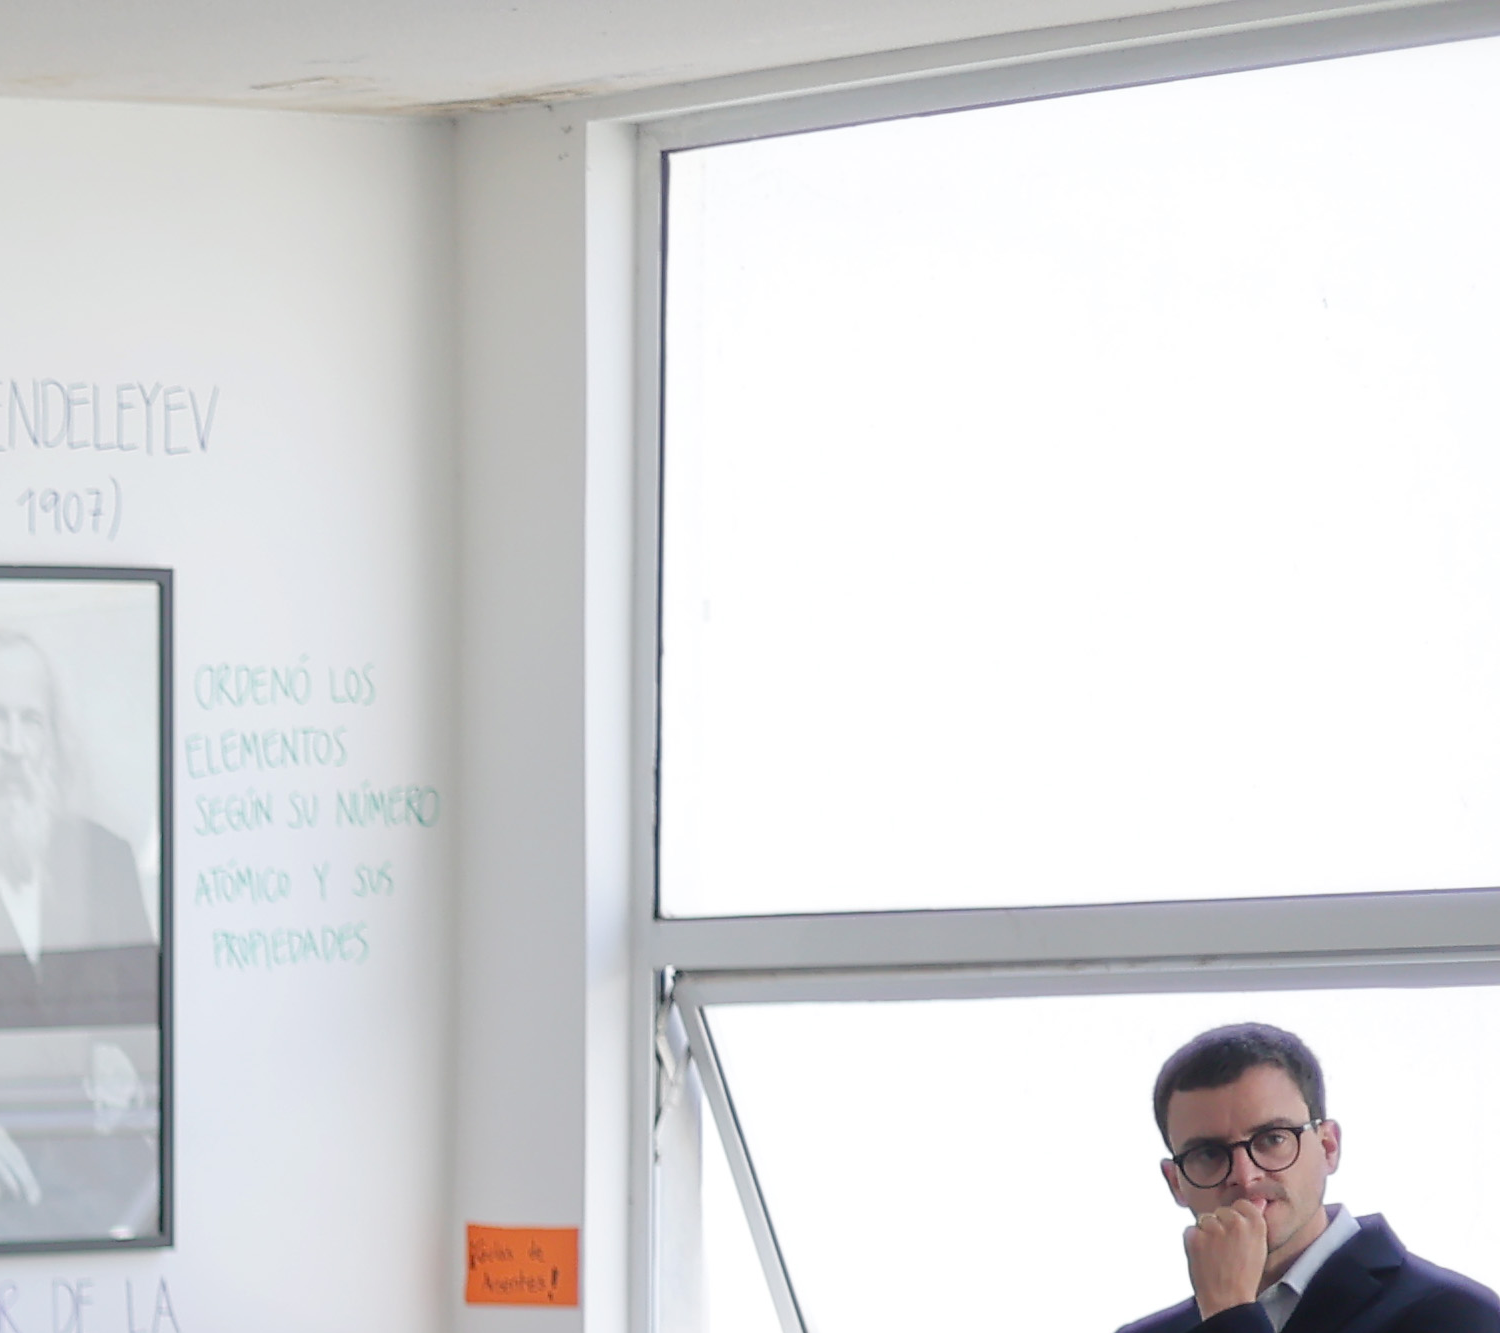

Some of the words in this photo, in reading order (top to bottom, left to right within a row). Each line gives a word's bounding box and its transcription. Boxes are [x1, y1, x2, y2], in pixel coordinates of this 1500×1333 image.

[15, 475, 124, 542] 1907)
[194, 652, 312, 710] ORDENÓ
[328, 662, 377, 706] LOS
[184, 725, 348, 780] ELEMENTOS
[194, 786, 273, 836] SEGÚN
[288, 790, 319, 829] SU
[336, 779, 442, 829] NÚMERO
[194, 858, 292, 906] ATÓMICO
[312, 860, 331, 900] Y
[352, 860, 395, 898] SUS
[212, 920, 371, 971] PROPIEDADES
